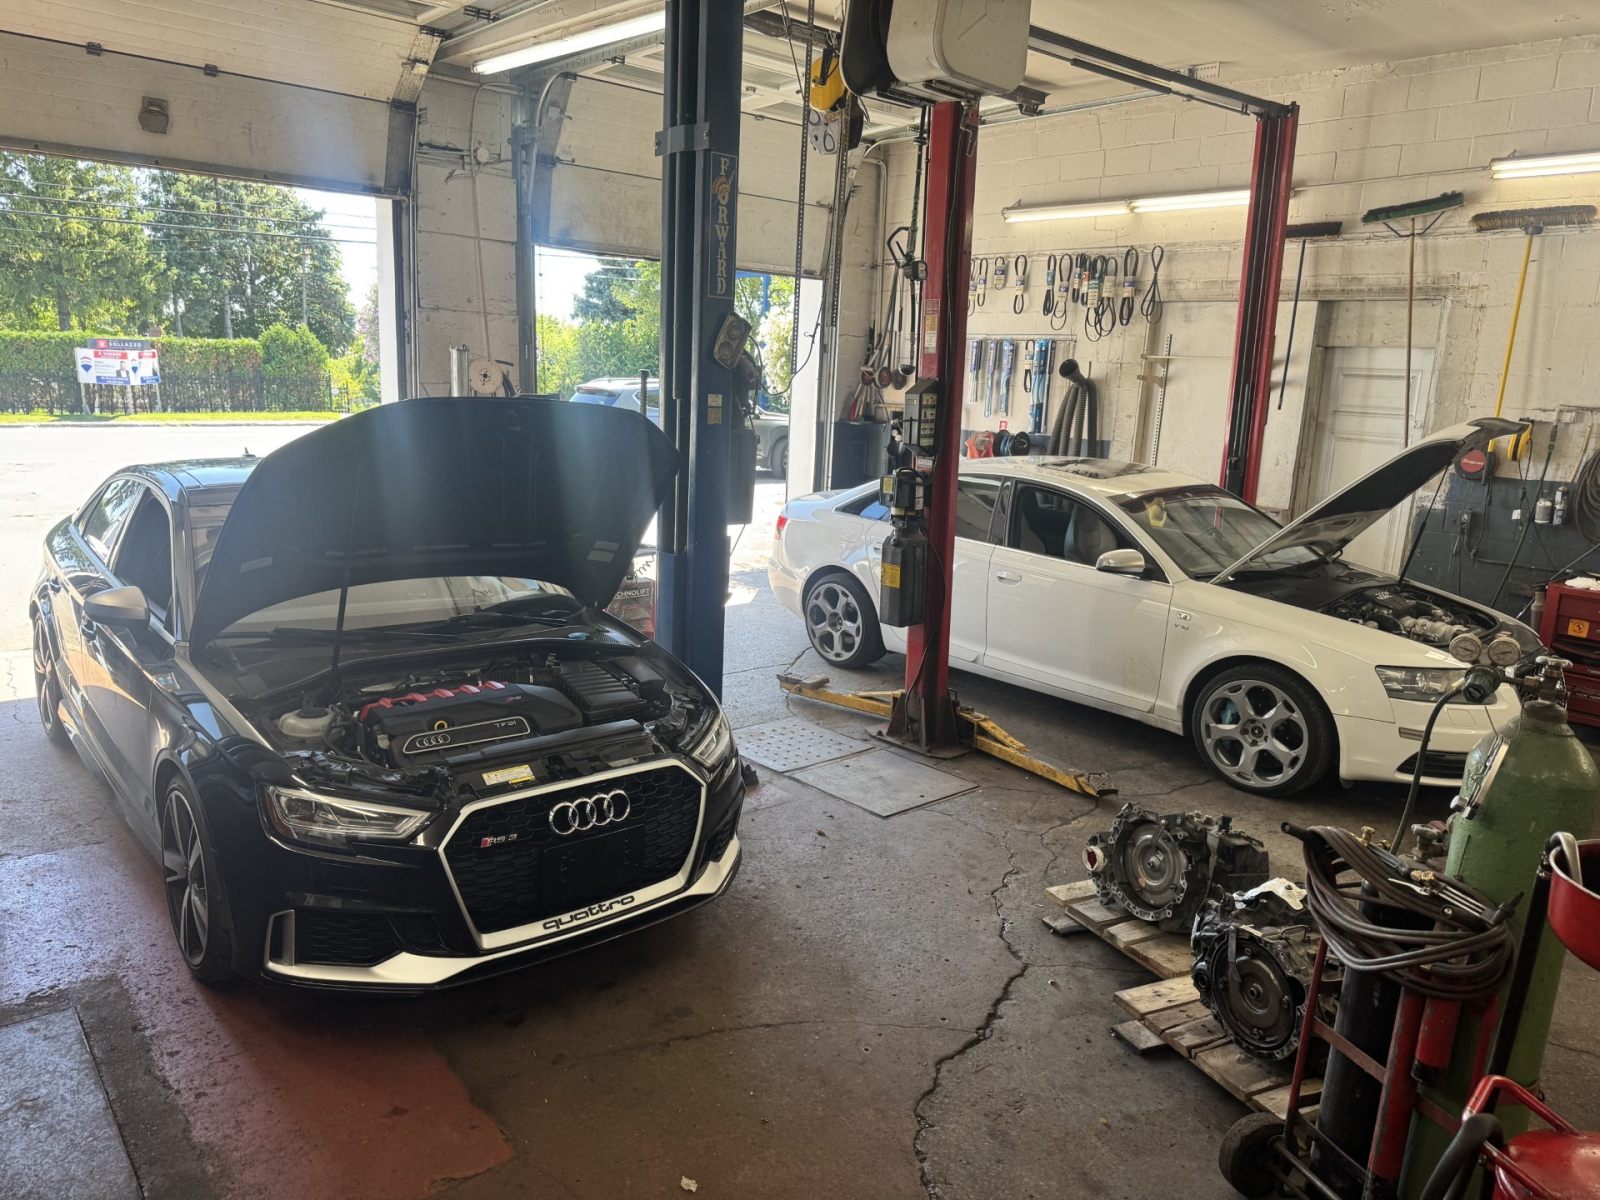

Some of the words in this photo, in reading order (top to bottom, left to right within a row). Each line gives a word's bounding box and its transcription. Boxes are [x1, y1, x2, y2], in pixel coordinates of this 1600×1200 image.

[715, 157, 731, 295] FORWARD
[615, 588, 650, 598] CHNOLIFT
[494, 720, 517, 728] TFSI
[542, 895, 635, 930] quattro
